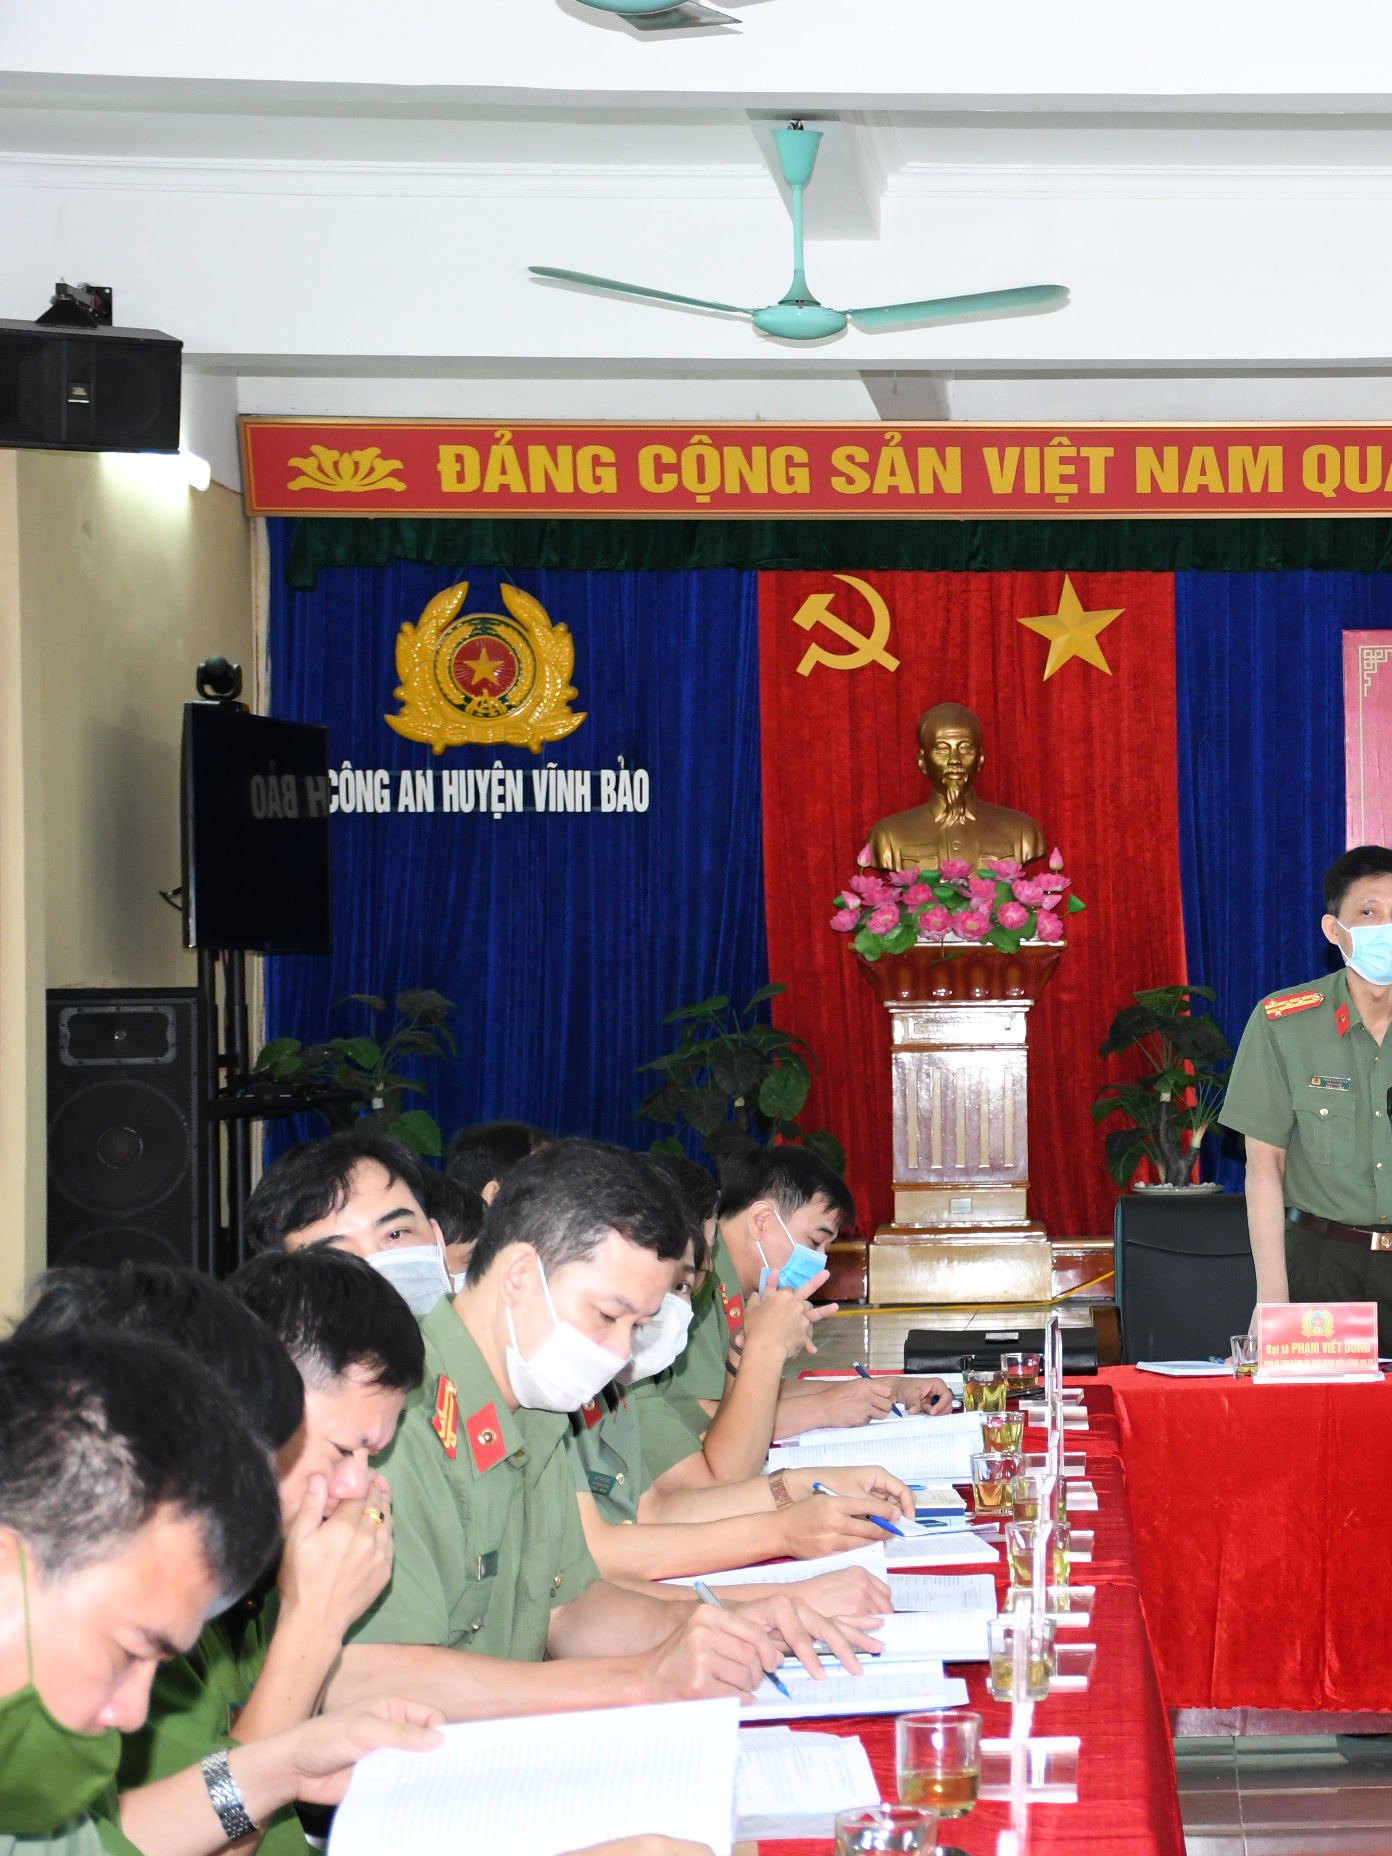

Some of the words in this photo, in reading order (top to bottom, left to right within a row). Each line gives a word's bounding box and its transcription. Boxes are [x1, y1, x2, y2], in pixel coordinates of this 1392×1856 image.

[437, 429, 617, 494] ĐẢNG
[638, 435, 811, 503] CỘNG
[831, 431, 962, 494] SẢN
[980, 436, 1114, 503] VIỆT
[1136, 445, 1283, 494] NAM
[328, 760, 391, 813] CÔNG
[397, 769, 434, 813] AN
[442, 760, 524, 820] HUYỆN
[531, 761, 592, 813] VĨNH
[600, 755, 650, 813] BẢO
[1291, 1342, 1320, 1356] PHẠM
[1322, 1339, 1342, 1354] VIẾT
